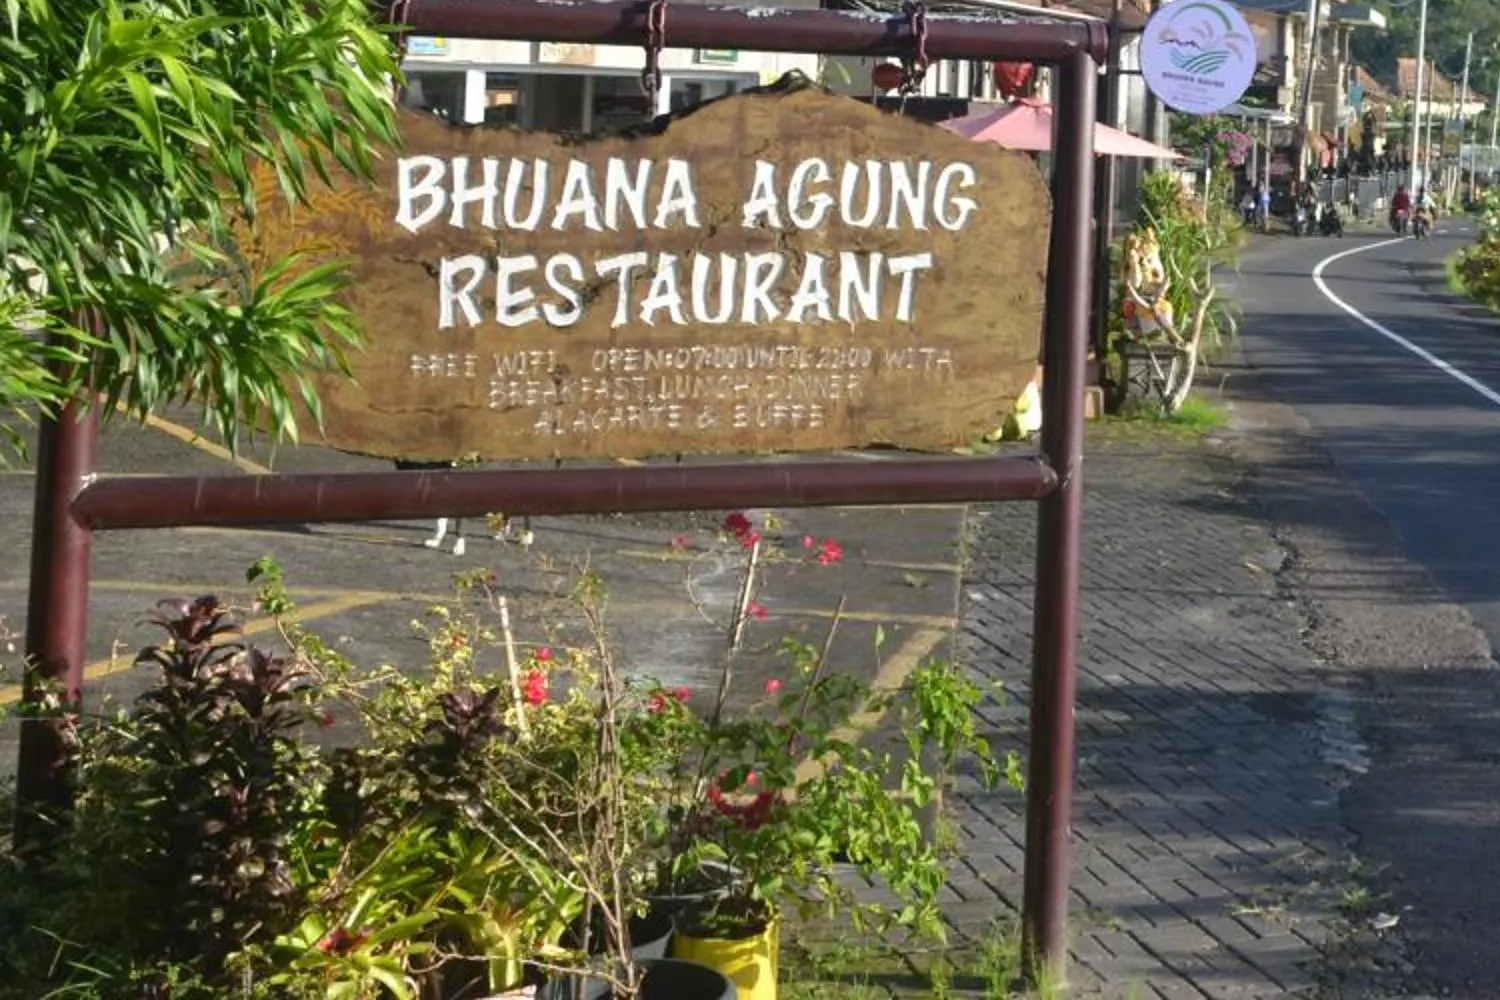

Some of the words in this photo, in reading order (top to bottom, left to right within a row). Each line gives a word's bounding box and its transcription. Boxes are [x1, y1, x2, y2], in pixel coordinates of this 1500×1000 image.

[395, 155, 700, 233] BHUANA
[743, 156, 978, 232] AGUNG
[438, 251, 932, 330] RESTAURANT
[410, 353, 480, 377] FREE
[493, 349, 557, 377] WIFI
